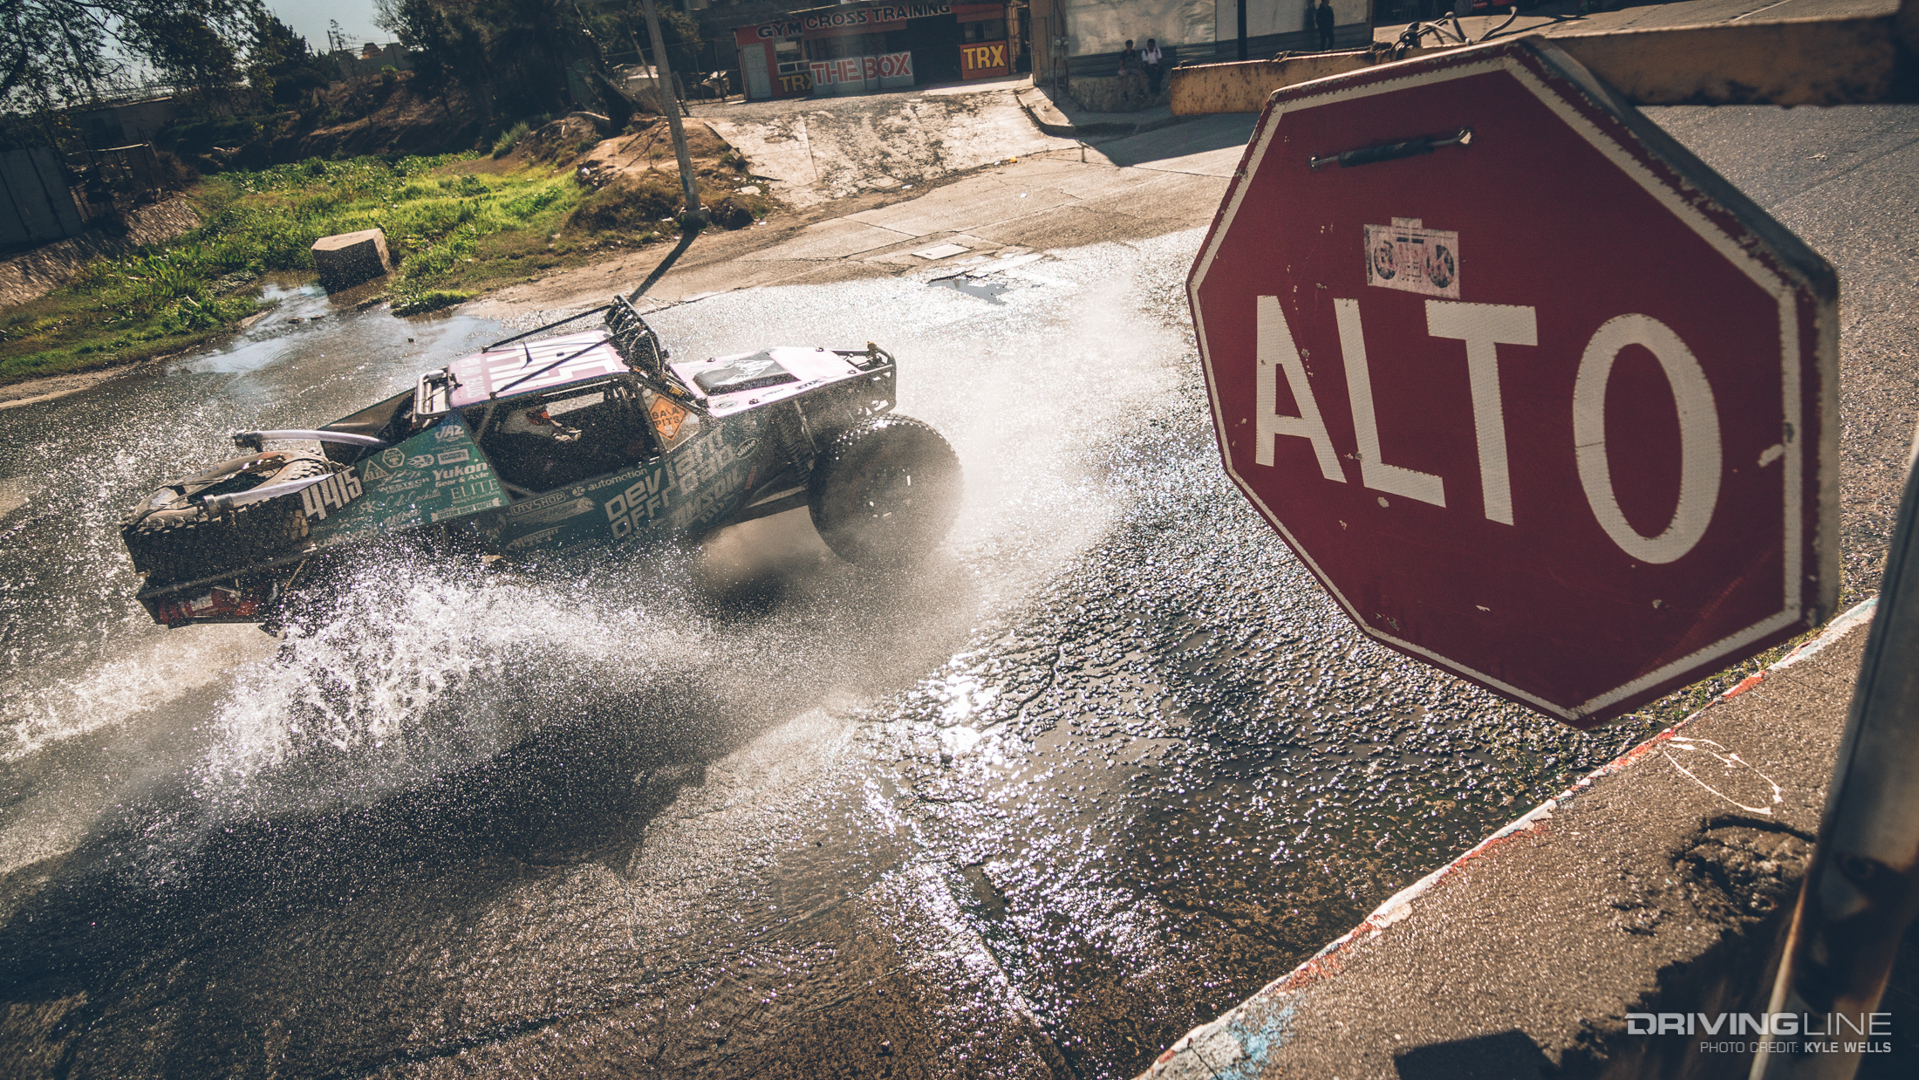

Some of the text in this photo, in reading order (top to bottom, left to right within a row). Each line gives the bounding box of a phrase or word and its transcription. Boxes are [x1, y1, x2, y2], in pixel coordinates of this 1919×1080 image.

[757, 4, 951, 39] GYM CROSS TRAINING
[810, 52, 913, 86] THE BOX
[963, 44, 1006, 70] TRX
[653, 416, 681, 428] PITS
[1256, 295, 1721, 564] ALTO
[433, 463, 488, 481] Yukon
[435, 480, 456, 488] Gear
[467, 472, 489, 481] Axle
[587, 468, 648, 491] automotion
[300, 467, 363, 520] 4415
[450, 479, 500, 499] ELITE
[670, 470, 743, 530] AMSOIL
